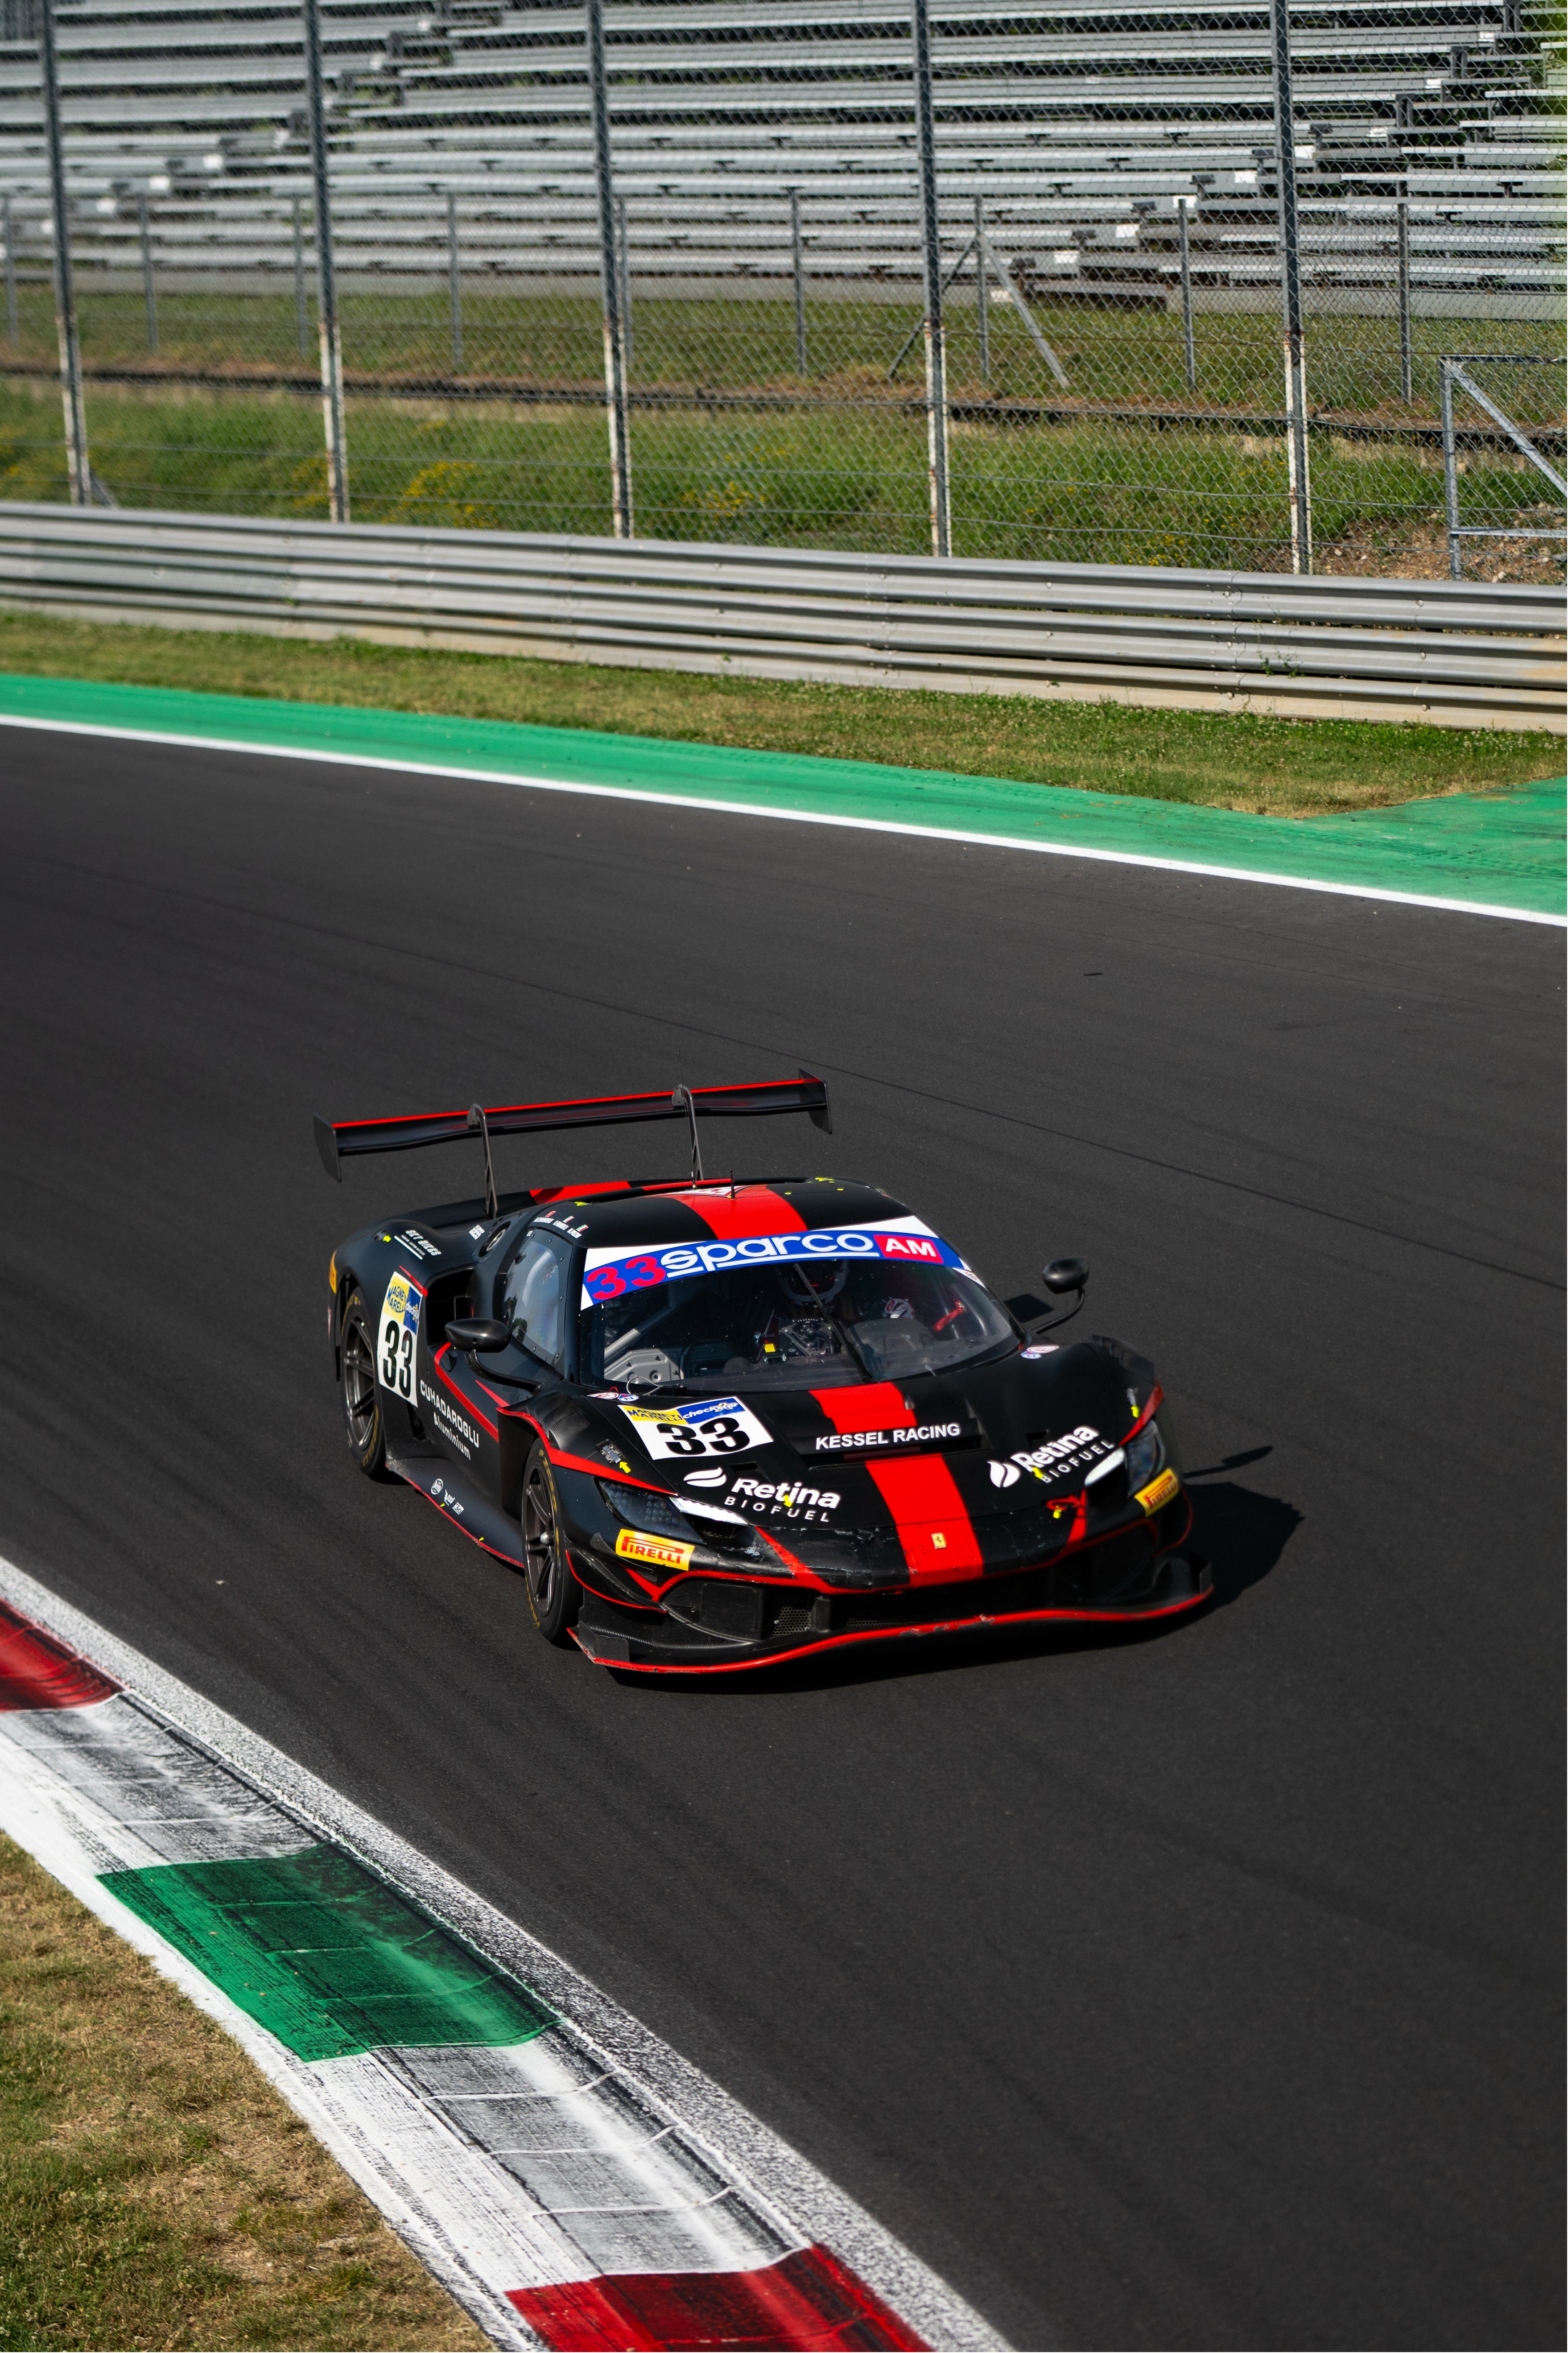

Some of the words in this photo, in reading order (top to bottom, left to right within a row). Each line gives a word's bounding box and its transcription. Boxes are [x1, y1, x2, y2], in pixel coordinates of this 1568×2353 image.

[586, 1256, 666, 1299] 33
[661, 1234, 874, 1272] sparco
[886, 1238, 937, 1257] AM
[383, 1320, 413, 1398] 33
[420, 1379, 479, 1449] CUHADAROGLU
[433, 1412, 471, 1461] Aluminium
[656, 1417, 751, 1456] 33
[816, 1432, 888, 1450] KESSEL
[893, 1424, 961, 1443] RACING
[1010, 1426, 1099, 1473] Retina
[1040, 1440, 1114, 1483] BIOFUEL
[724, 1496, 830, 1523] BIOFUEL
[731, 1478, 840, 1509] Retina
[621, 1536, 685, 1564] PIRELLI
